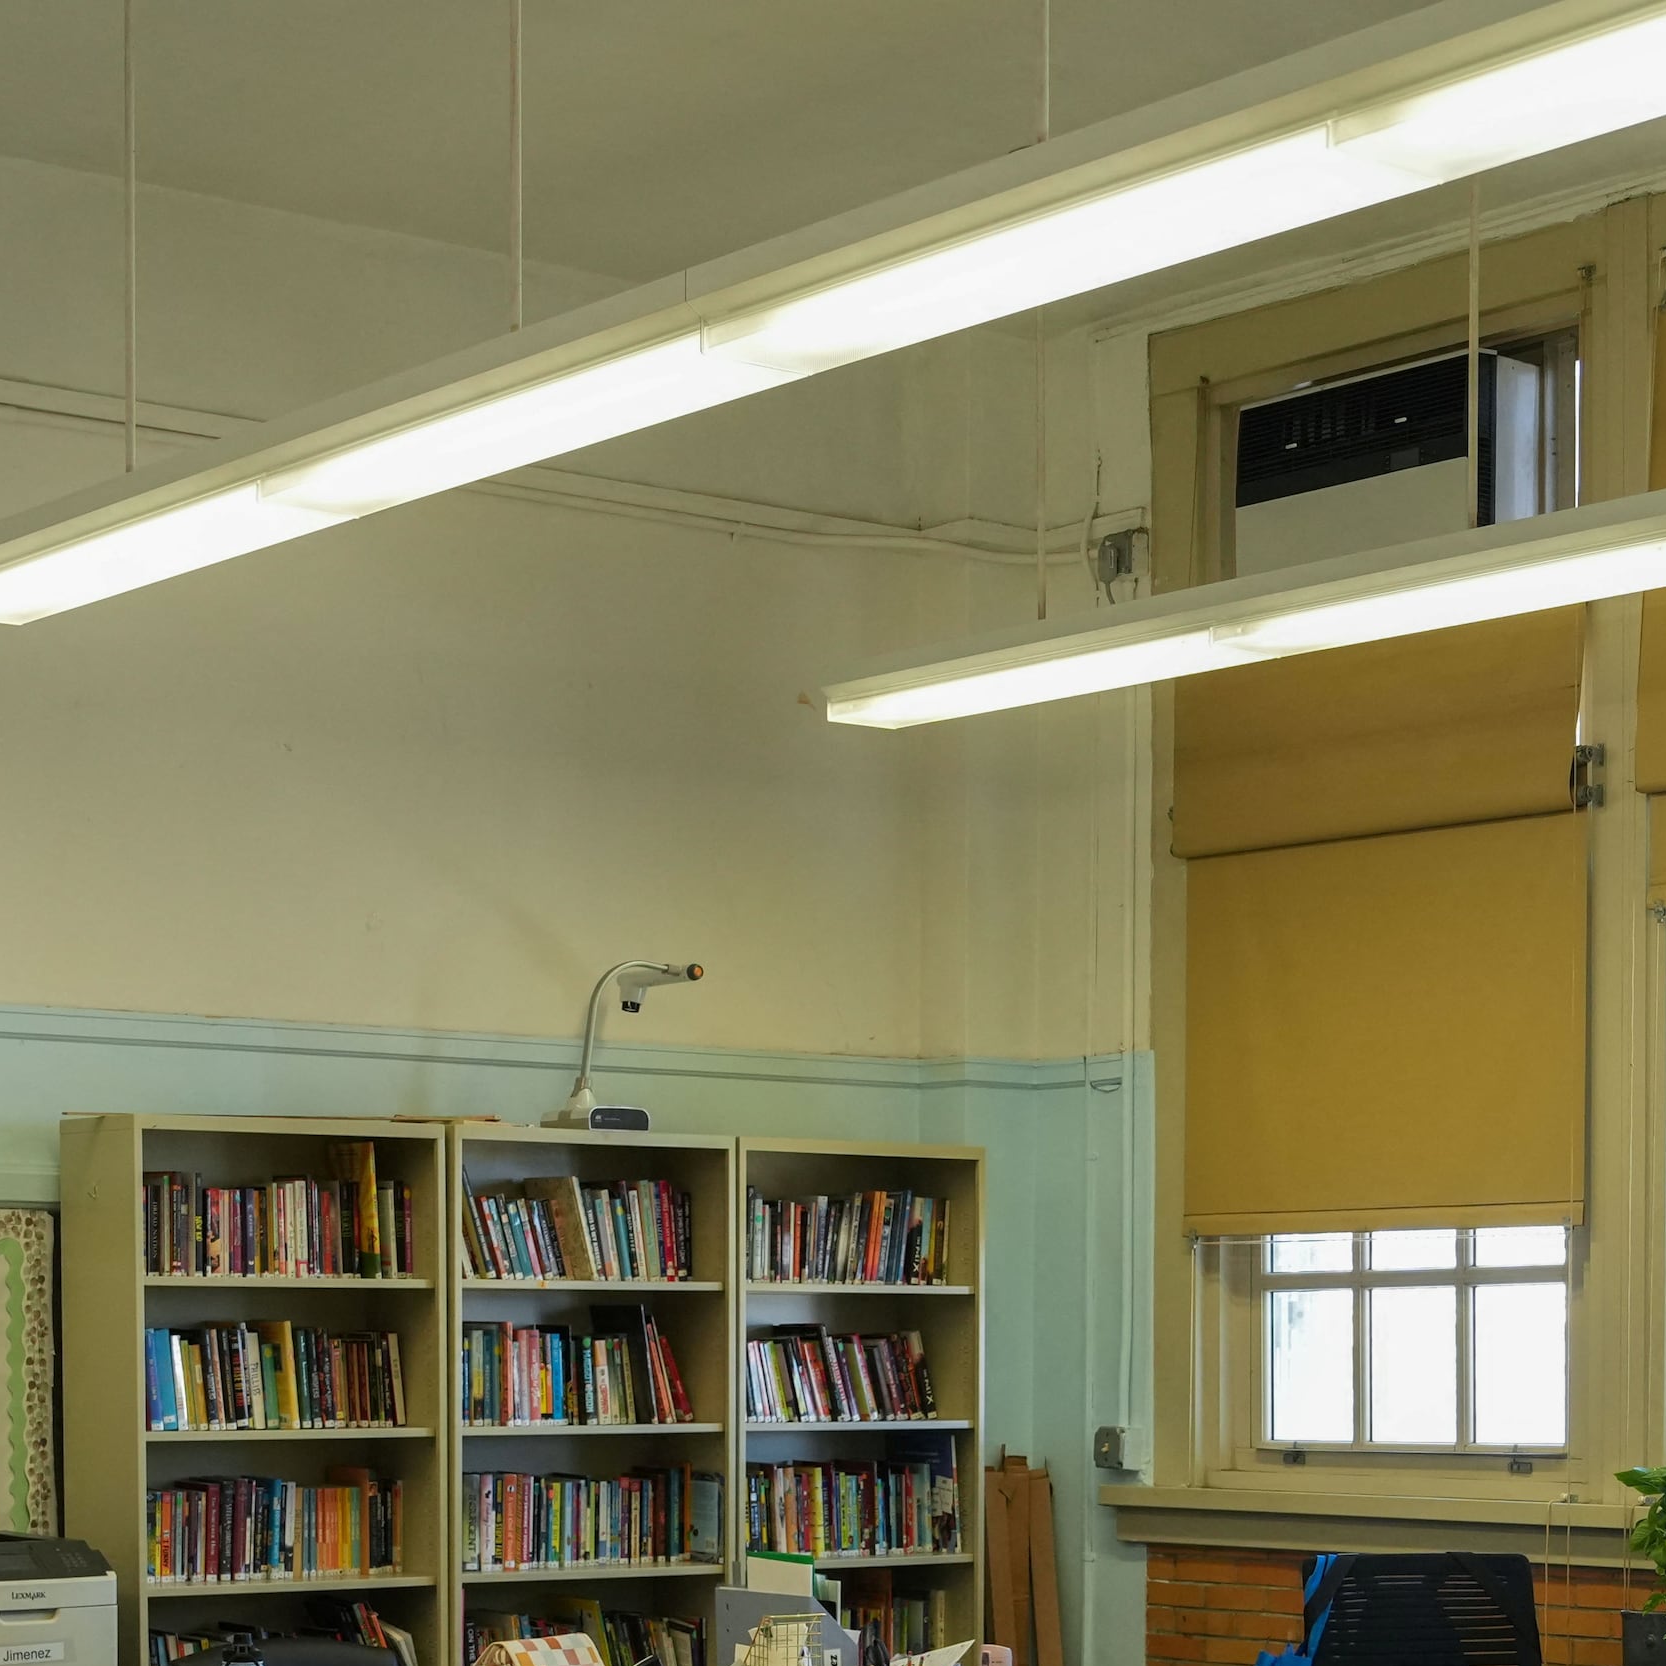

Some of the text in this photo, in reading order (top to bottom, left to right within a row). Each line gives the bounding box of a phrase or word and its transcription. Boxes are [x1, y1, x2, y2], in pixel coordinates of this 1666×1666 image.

[913, 1263, 919, 1272] X
[926, 1395, 933, 1405] X
[468, 1494, 477, 1553] INSURGENT
[12, 1591, 46, 1601] LEXMARK
[3, 1649, 51, 1662] Jimenez
